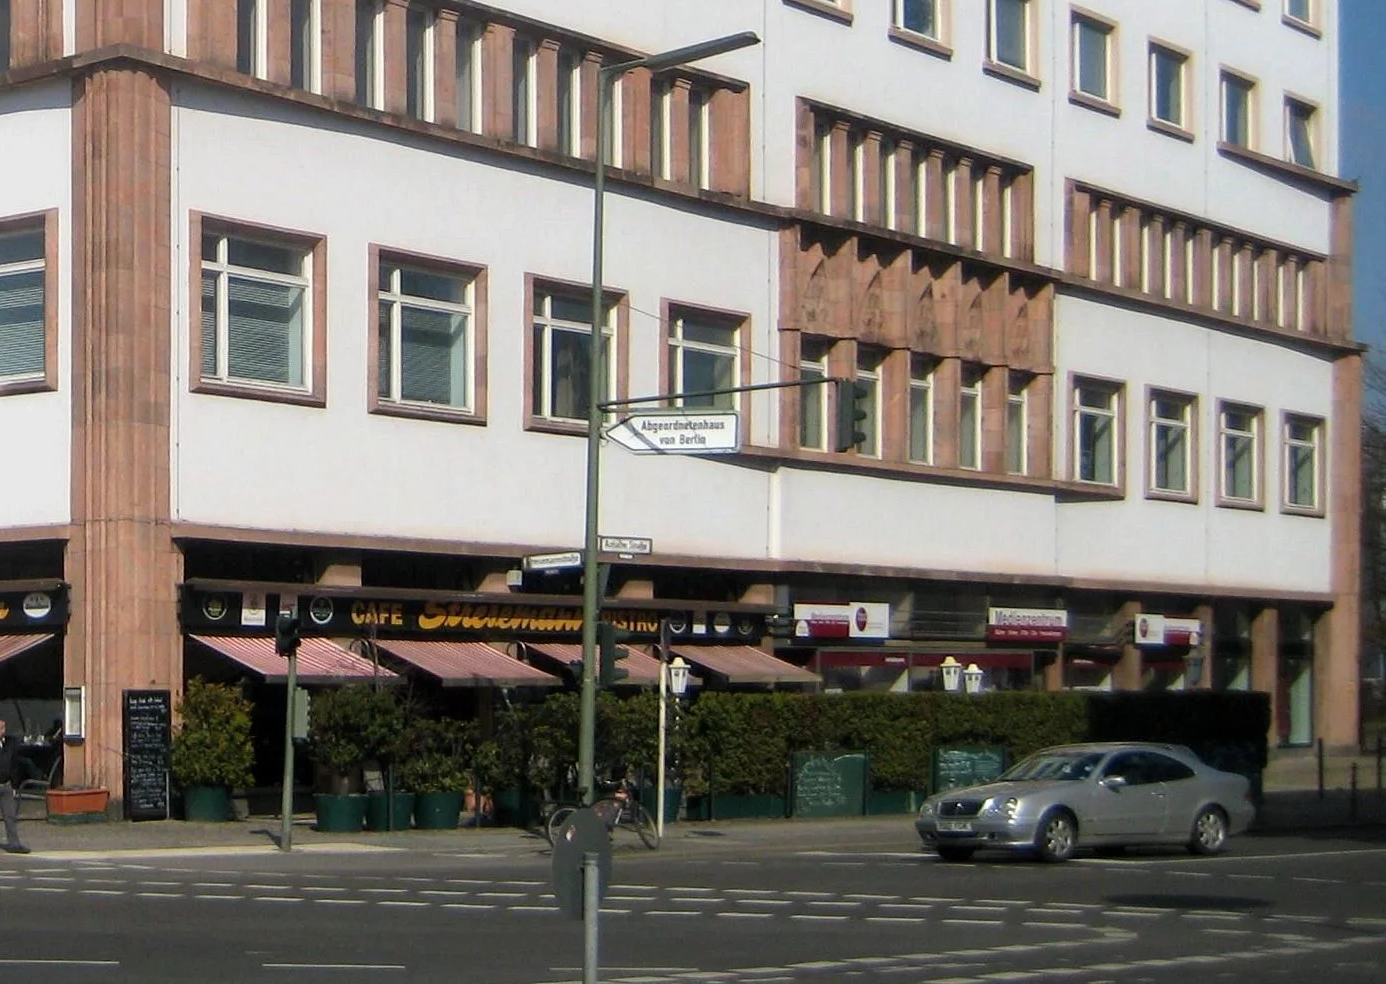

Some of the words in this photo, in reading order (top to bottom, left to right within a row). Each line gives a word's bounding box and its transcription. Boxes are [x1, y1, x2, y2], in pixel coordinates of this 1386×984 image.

[641, 419, 725, 433] Abgeordnetenhaus
[659, 437, 675, 445] von
[679, 434, 706, 445] Berlin
[351, 600, 403, 625] CAFE
